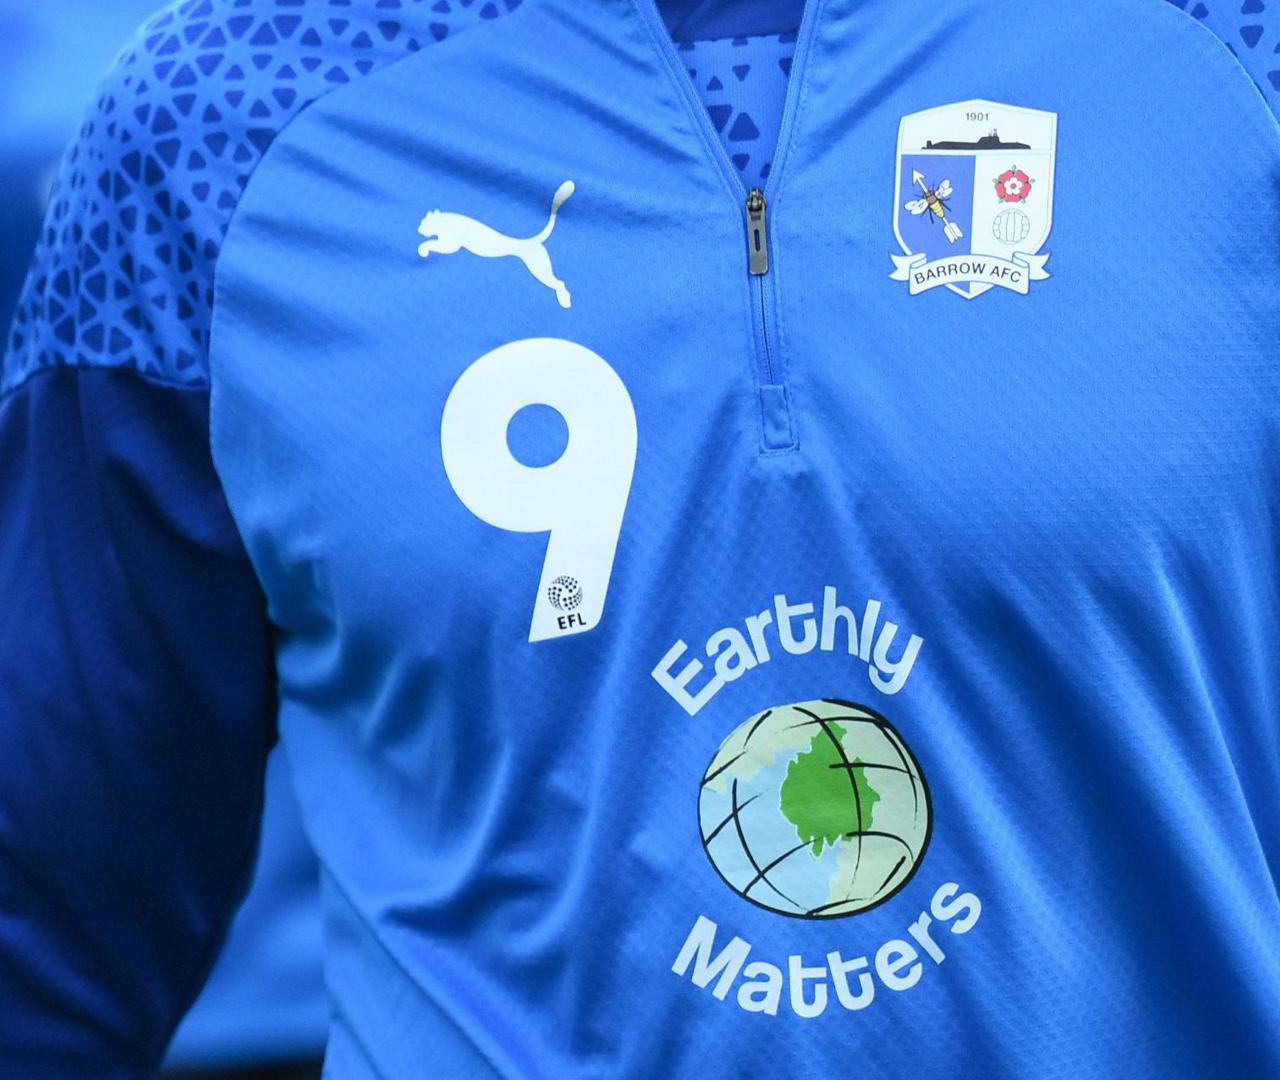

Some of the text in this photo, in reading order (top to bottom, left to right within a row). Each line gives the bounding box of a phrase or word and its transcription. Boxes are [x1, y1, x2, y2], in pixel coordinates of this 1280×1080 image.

[966, 112, 990, 122] 1901
[913, 262, 1022, 285] BARROW AFC
[440, 337, 638, 643] 9
[557, 612, 587, 630] EFL
[650, 585, 924, 717] Earthly
[671, 881, 982, 1019] Matters
